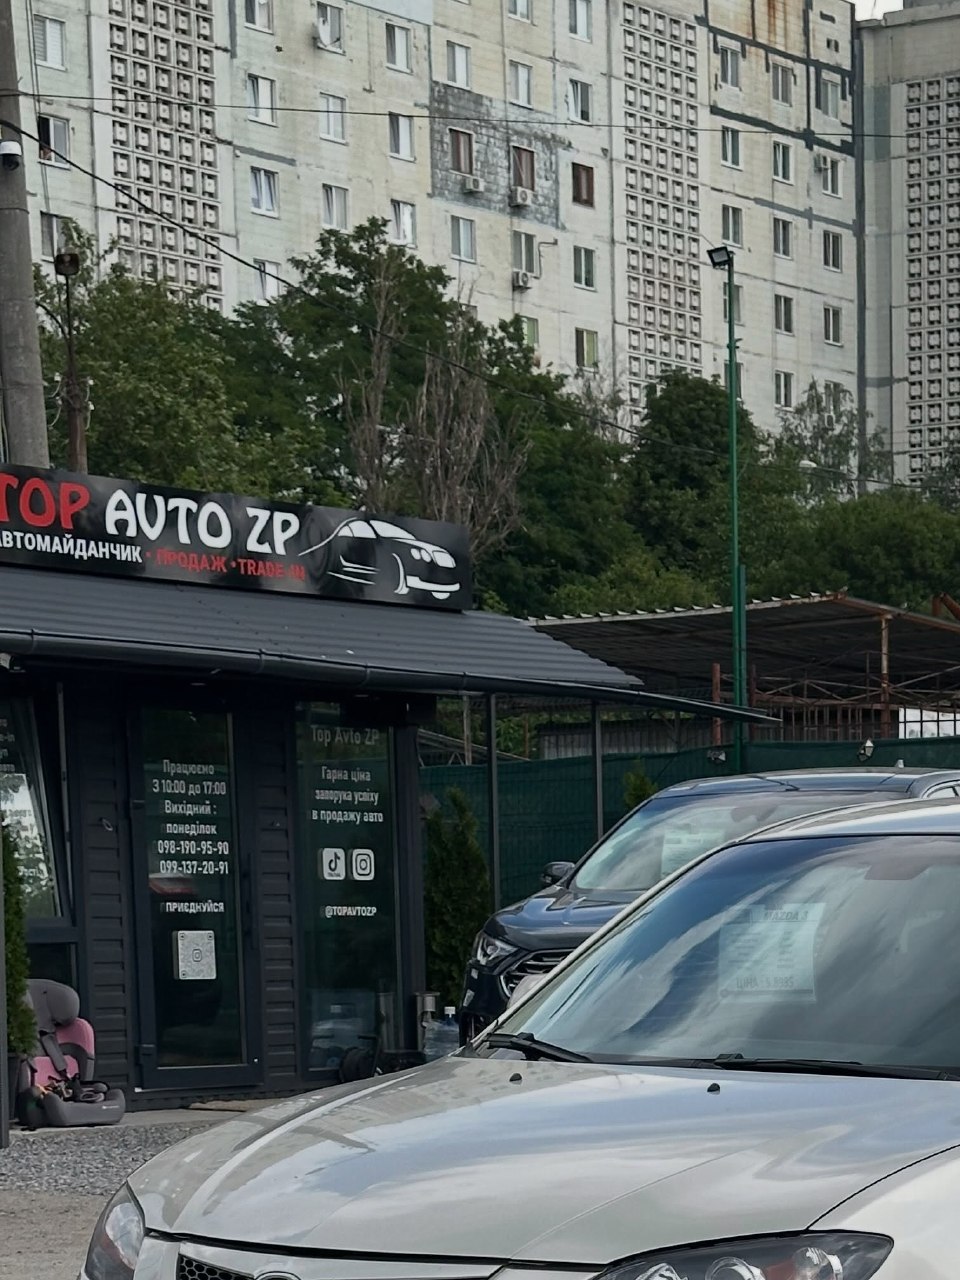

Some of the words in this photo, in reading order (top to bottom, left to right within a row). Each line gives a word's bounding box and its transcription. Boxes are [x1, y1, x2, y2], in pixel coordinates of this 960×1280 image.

[0, 472, 91, 529] TOP
[246, 507, 300, 556] ZP
[0, 530, 142, 563] ВТОМАЙДАНЧИК
[156, 547, 227, 573] ПРОДАЖ
[310, 725, 331, 746] Top
[335, 727, 362, 745] Avto
[365, 728, 380, 746] ZP
[163, 759, 214, 776] Працюємо
[321, 766, 348, 782] Гарна
[351, 767, 371, 782] ціна
[161, 780, 186, 794] 10:00
[188, 785, 201, 796] до
[203, 781, 226, 795] 17:00
[164, 800, 211, 816] Вихідний
[320, 810, 361, 824] продажу
[363, 811, 384, 822] авто
[166, 821, 217, 836] понеділок
[157, 840, 229, 855] 098-190-95-90
[160, 860, 229, 875] 099-137-20-91
[166, 900, 224, 914] ПРИЄДНУЙСЯ
[325, 906, 377, 918] @TOPAVTOZP
